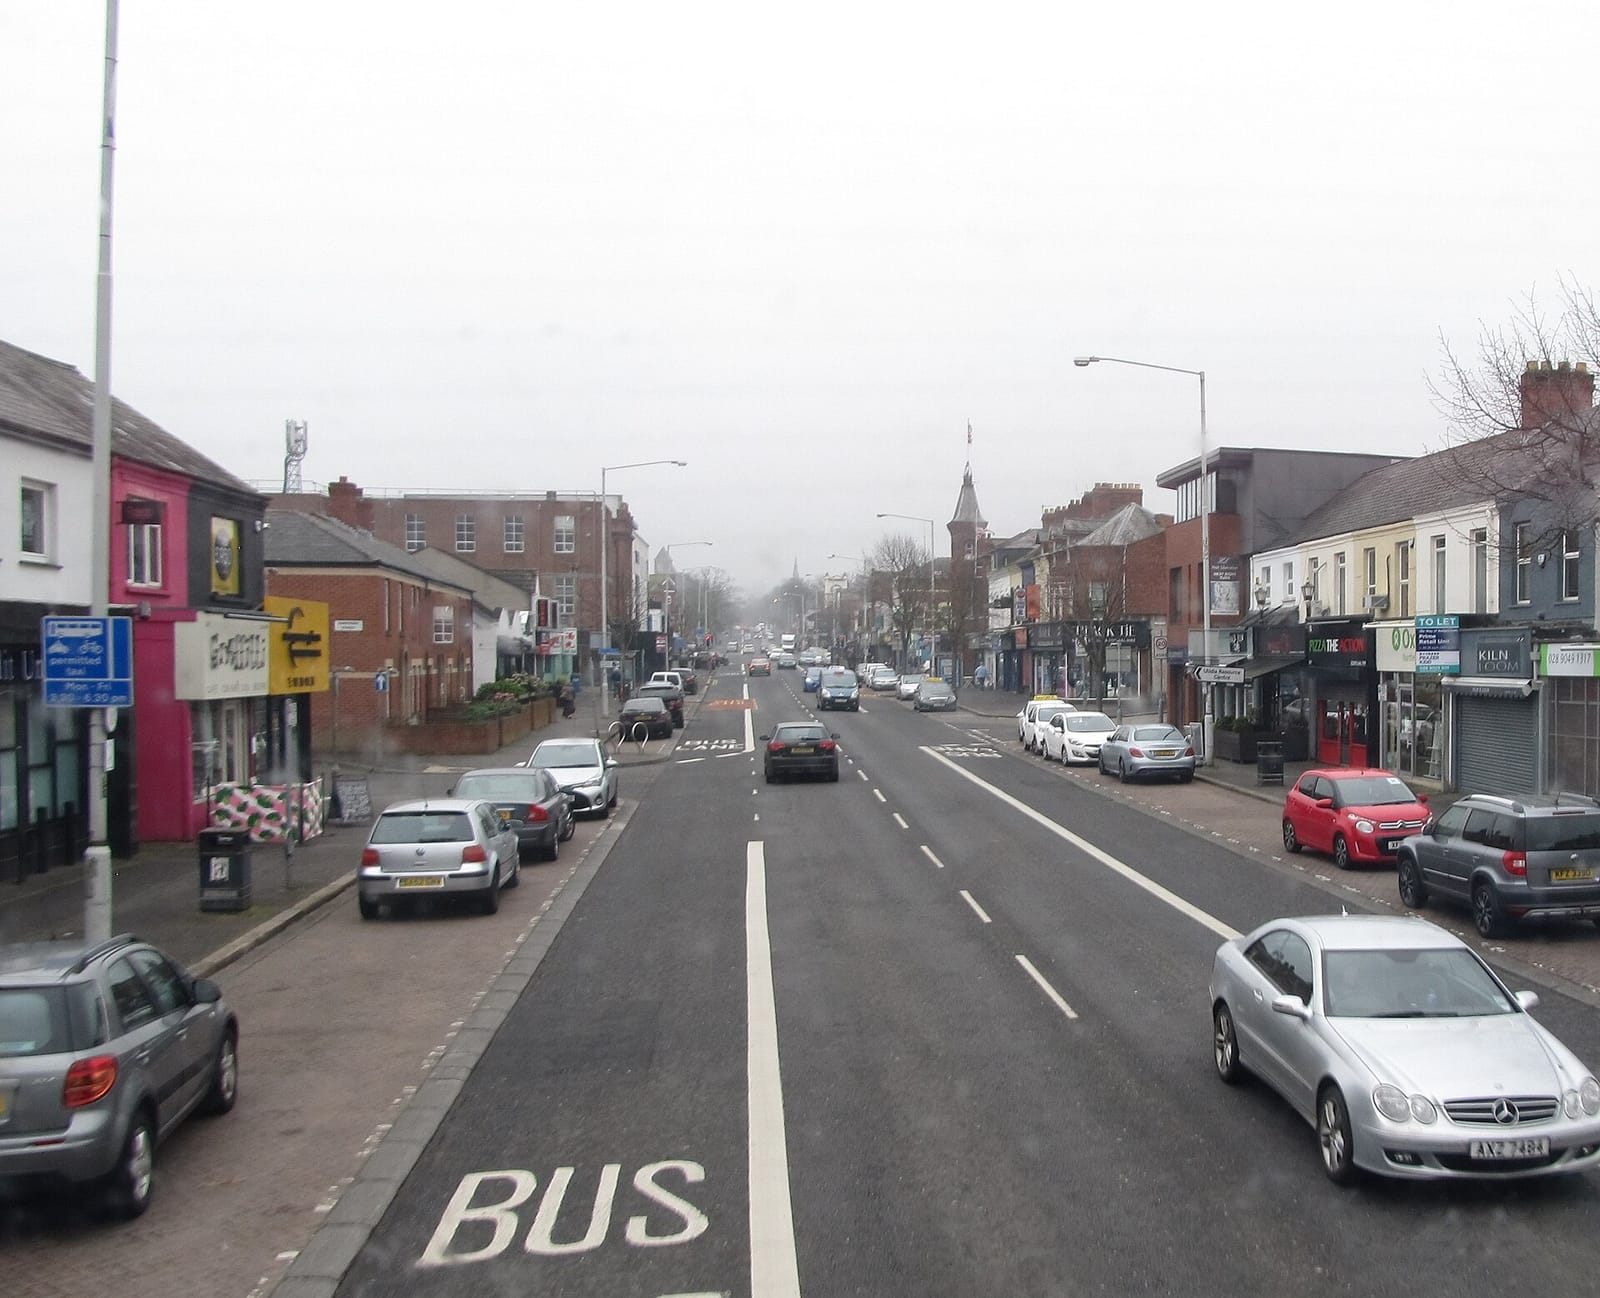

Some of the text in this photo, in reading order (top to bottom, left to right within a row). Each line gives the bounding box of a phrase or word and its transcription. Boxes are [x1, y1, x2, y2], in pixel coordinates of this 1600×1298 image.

[1419, 617, 1456, 626] TO LET
[1402, 628, 1416, 649] Ox
[1309, 639, 1326, 652] PIZZA
[1326, 639, 1339, 653] THE
[1339, 638, 1366, 653] ACTION
[1479, 649, 1509, 661] KILN
[50, 656, 102, 666] permitted
[64, 682, 89, 691] Mon
[97, 681, 112, 691] Fri
[110, 695, 128, 703] pm
[414, 1160, 709, 1268] BUS
